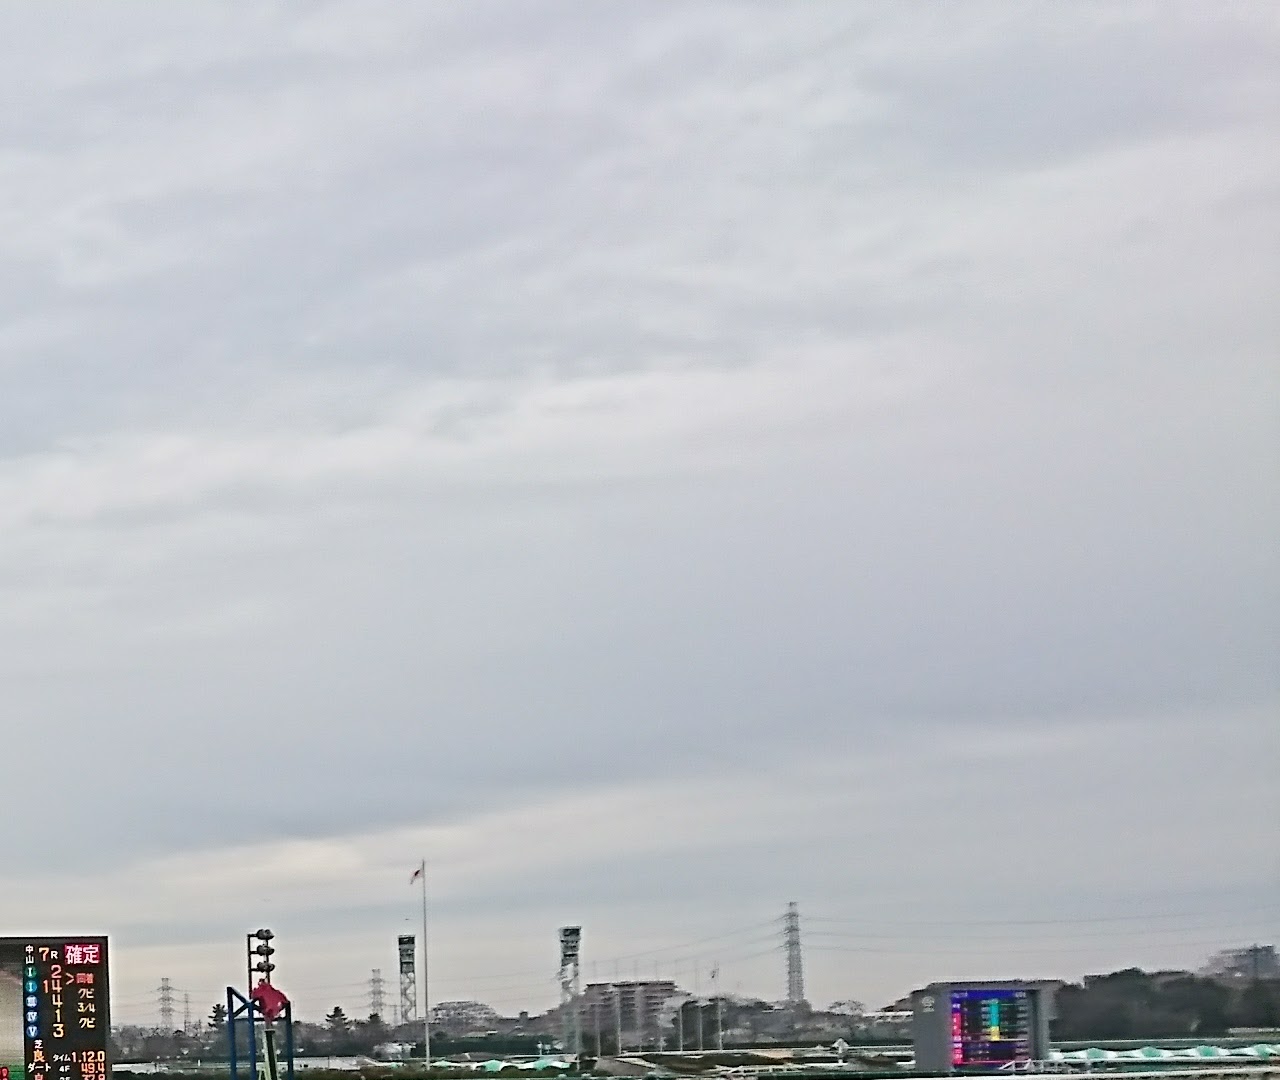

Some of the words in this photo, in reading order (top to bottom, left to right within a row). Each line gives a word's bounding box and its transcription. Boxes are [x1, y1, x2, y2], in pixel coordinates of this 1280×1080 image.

[25, 945, 34, 964] 中山
[65, 945, 99, 964] 確定
[51, 965, 62, 979] 2
[78, 988, 94, 999] クビ
[52, 994, 63, 1008] 4
[55, 1009, 60, 1022] 1
[79, 1017, 96, 1028] クビ
[53, 1024, 64, 1038] 3
[33, 1049, 45, 1062] 良
[53, 1054, 71, 1062] タイム
[71, 1051, 105, 1063] 1.12.0
[28, 1062, 51, 1073] ダート
[81, 1062, 105, 1073] 49.4
